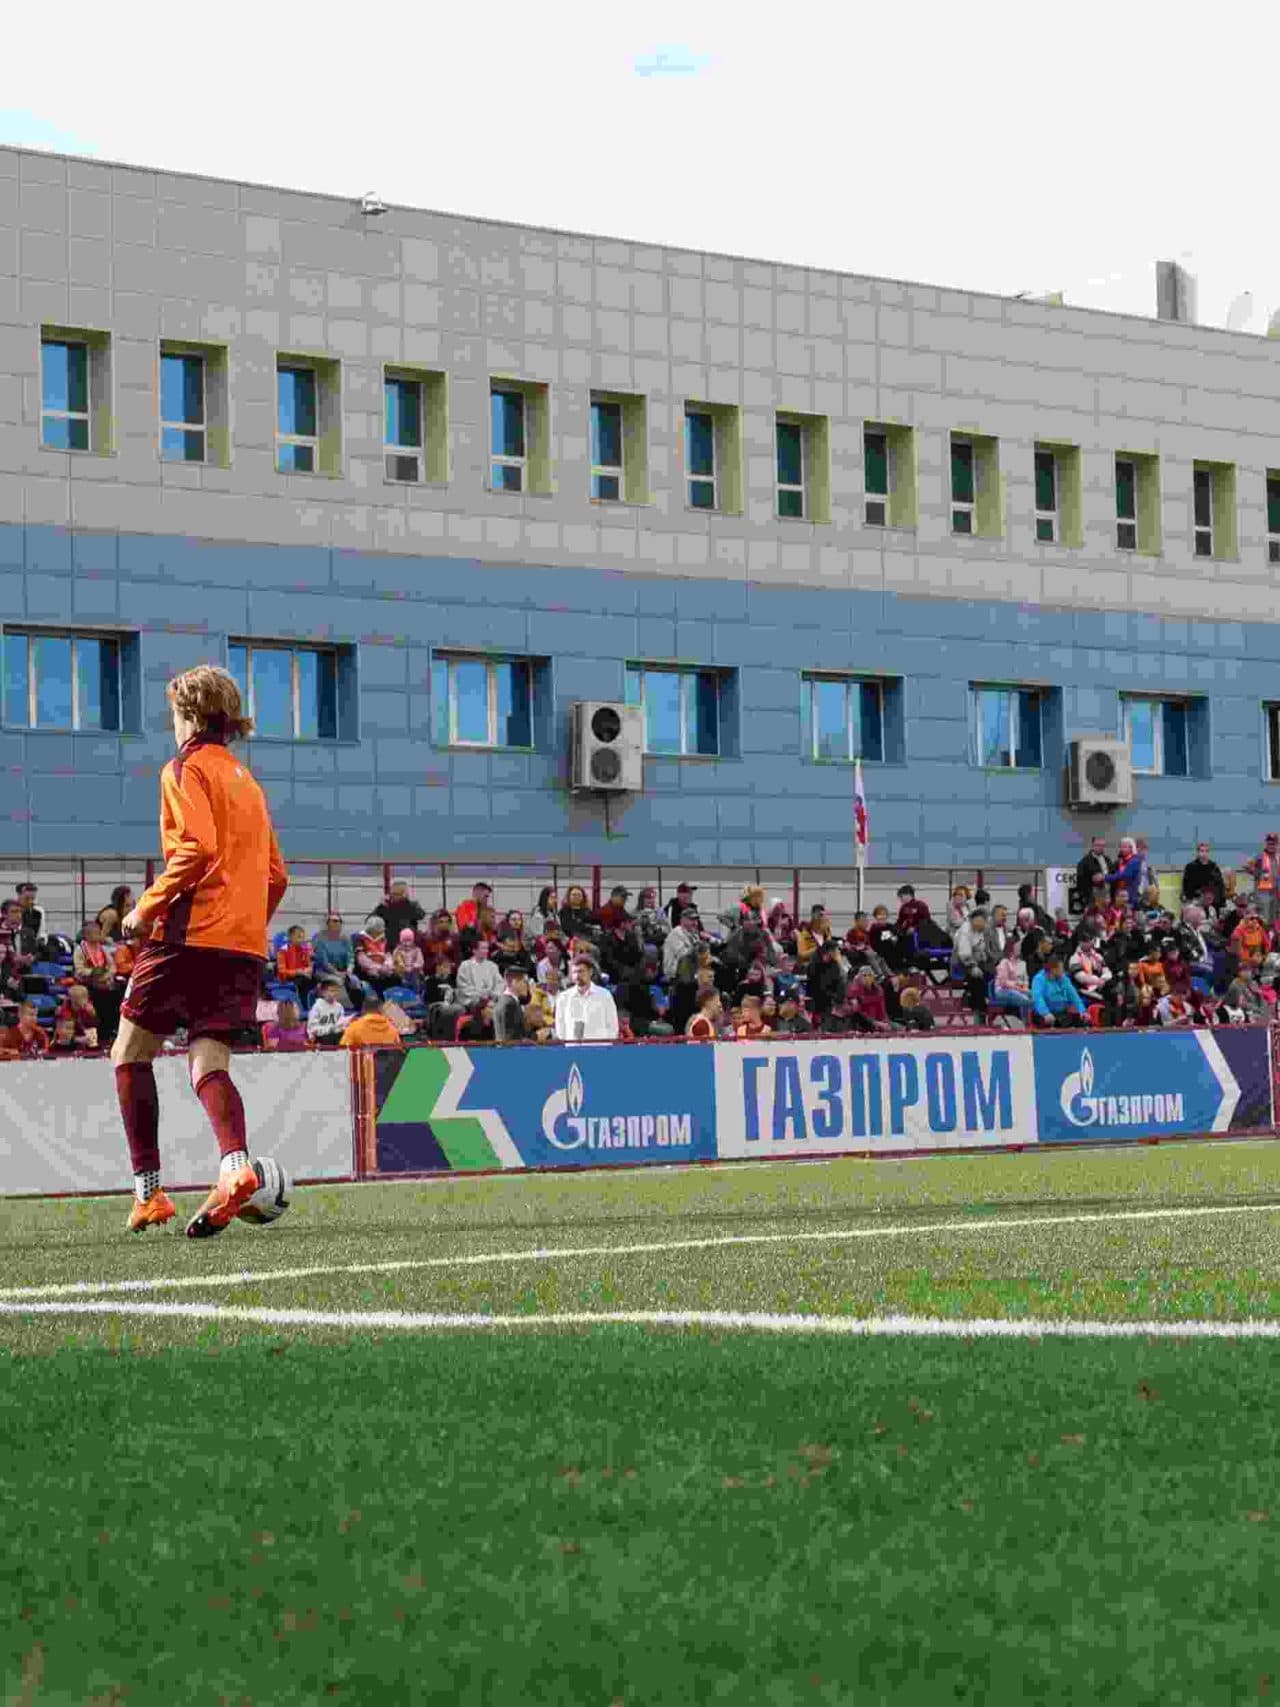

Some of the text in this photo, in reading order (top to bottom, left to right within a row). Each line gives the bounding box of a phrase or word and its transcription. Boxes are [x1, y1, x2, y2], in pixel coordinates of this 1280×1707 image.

[742, 1050, 1014, 1141] ГАЗПРОМ
[1099, 1093, 1184, 1126] ГАЗПРОМ
[587, 1113, 691, 1149] ГАЗПРОМ
